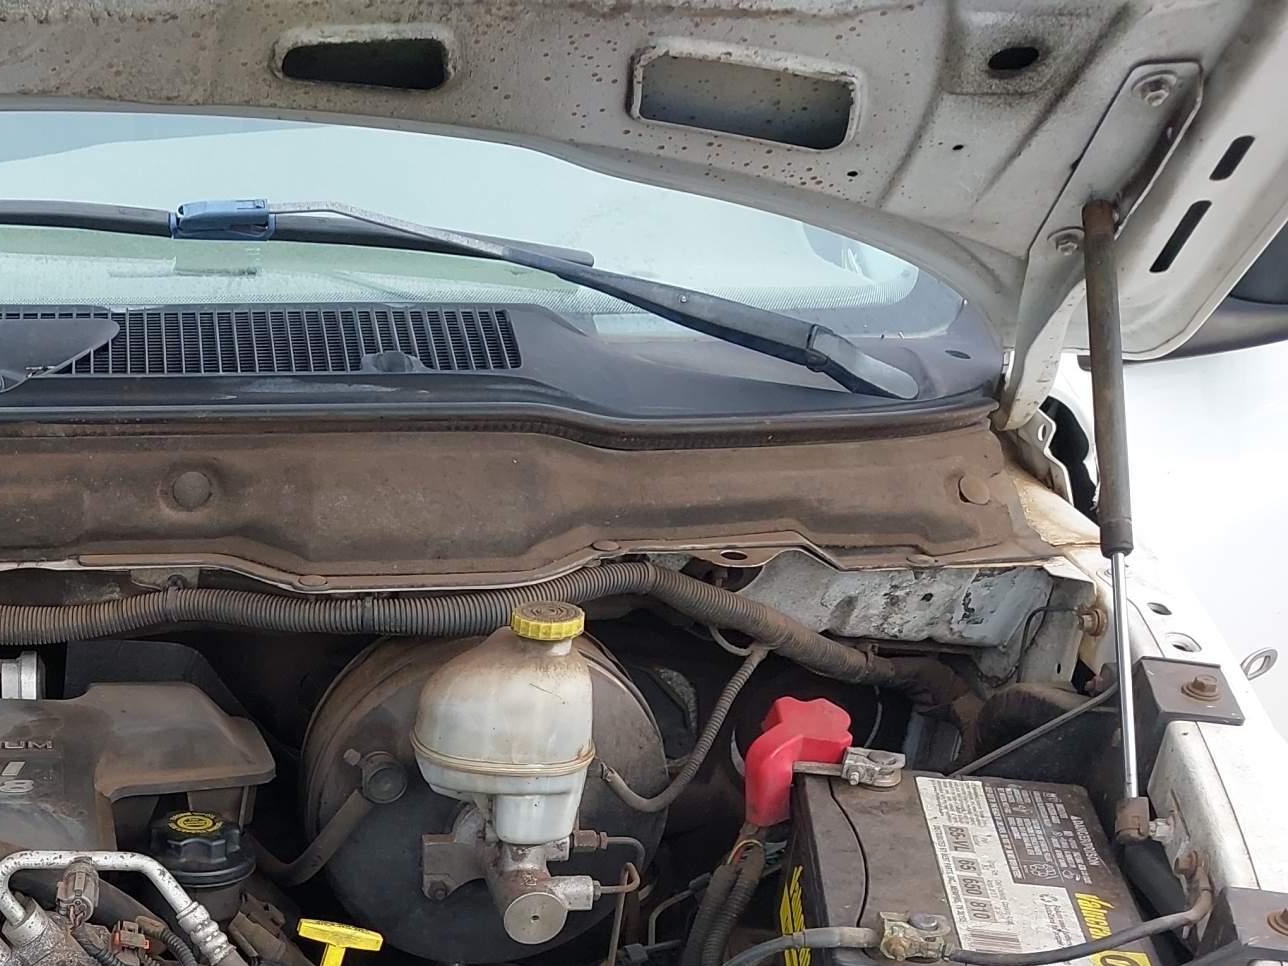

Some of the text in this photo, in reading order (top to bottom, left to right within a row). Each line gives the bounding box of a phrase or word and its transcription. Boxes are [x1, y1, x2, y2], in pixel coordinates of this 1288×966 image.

[948, 826, 970, 851] 65-VL
[960, 858, 977, 872] 65
[963, 876, 983, 896] 650
[970, 901, 992, 920] 810
